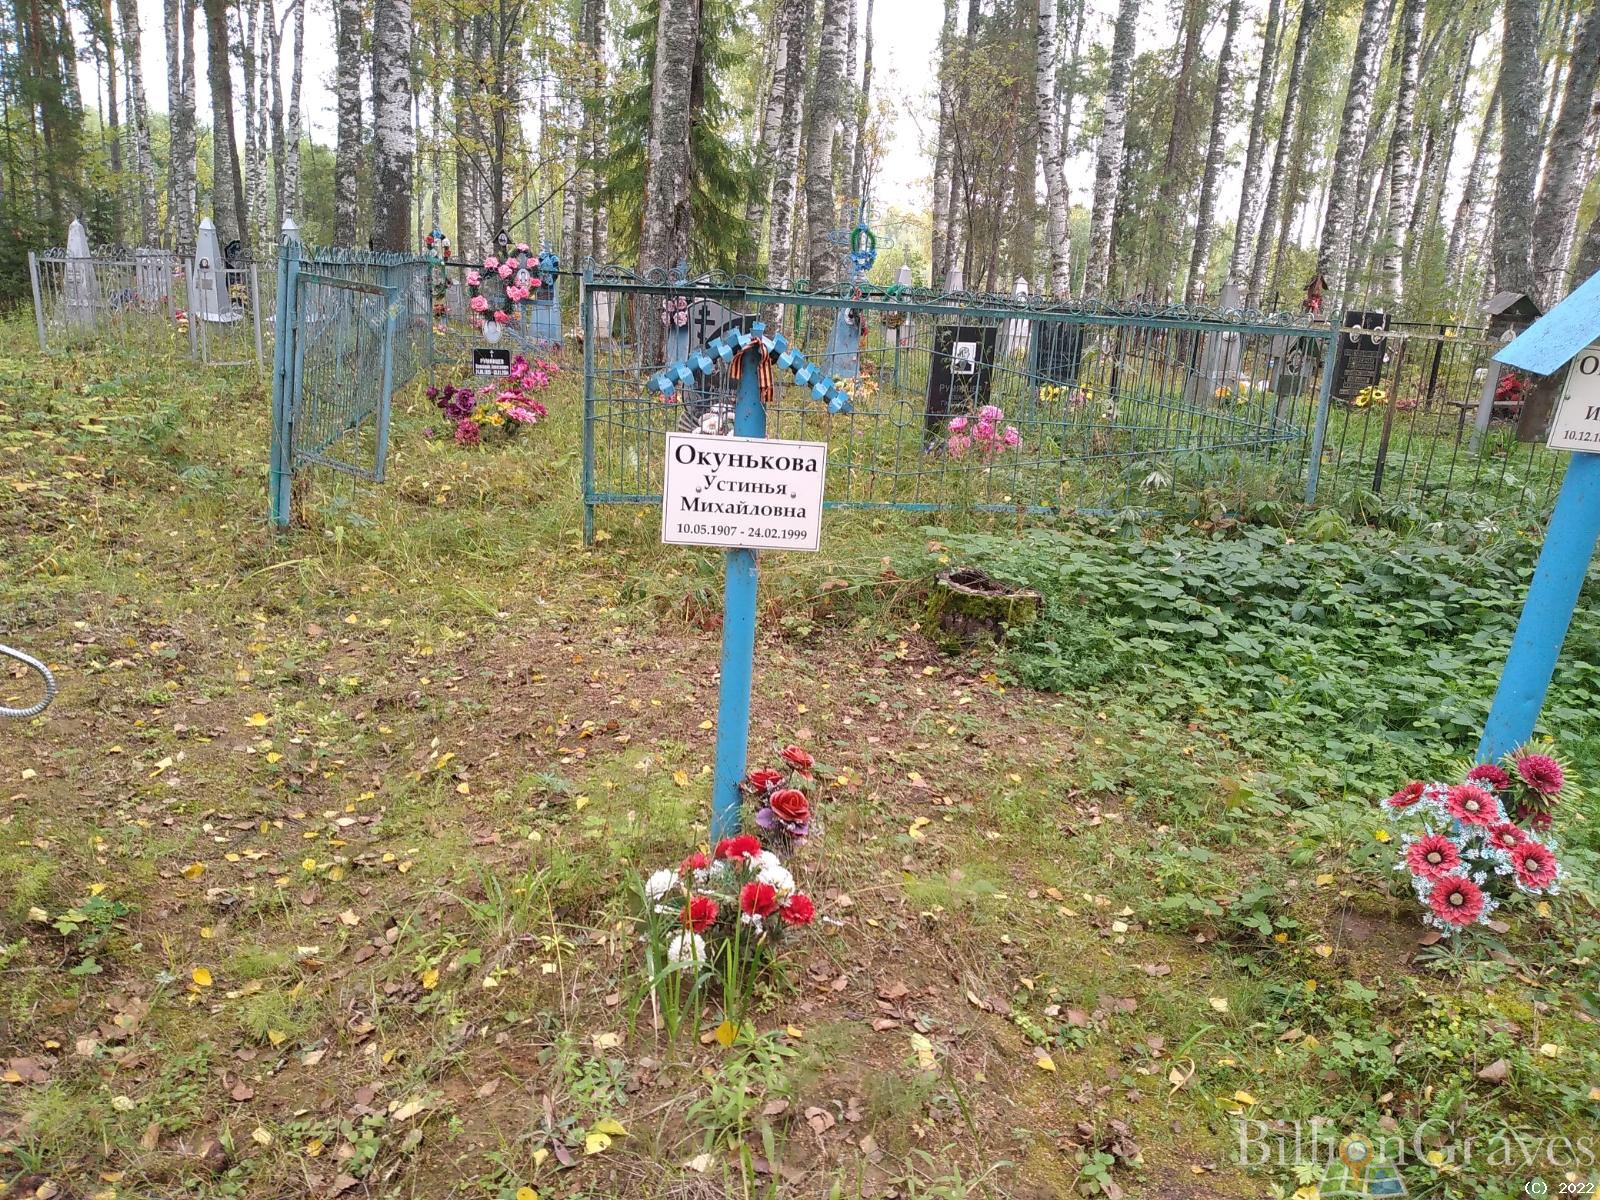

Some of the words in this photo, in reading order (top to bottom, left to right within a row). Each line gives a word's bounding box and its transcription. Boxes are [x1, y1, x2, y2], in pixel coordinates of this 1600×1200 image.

[1580, 355, 1600, 376] О
[1564, 429, 1600, 443] 10.12.1
[675, 444, 818, 473] Окунькова
[704, 474, 787, 495] Устинья
[680, 496, 806, 519] Михайловна
[677, 523, 737, 536] 10.05.1907
[748, 527, 808, 540] 24.02.1999
